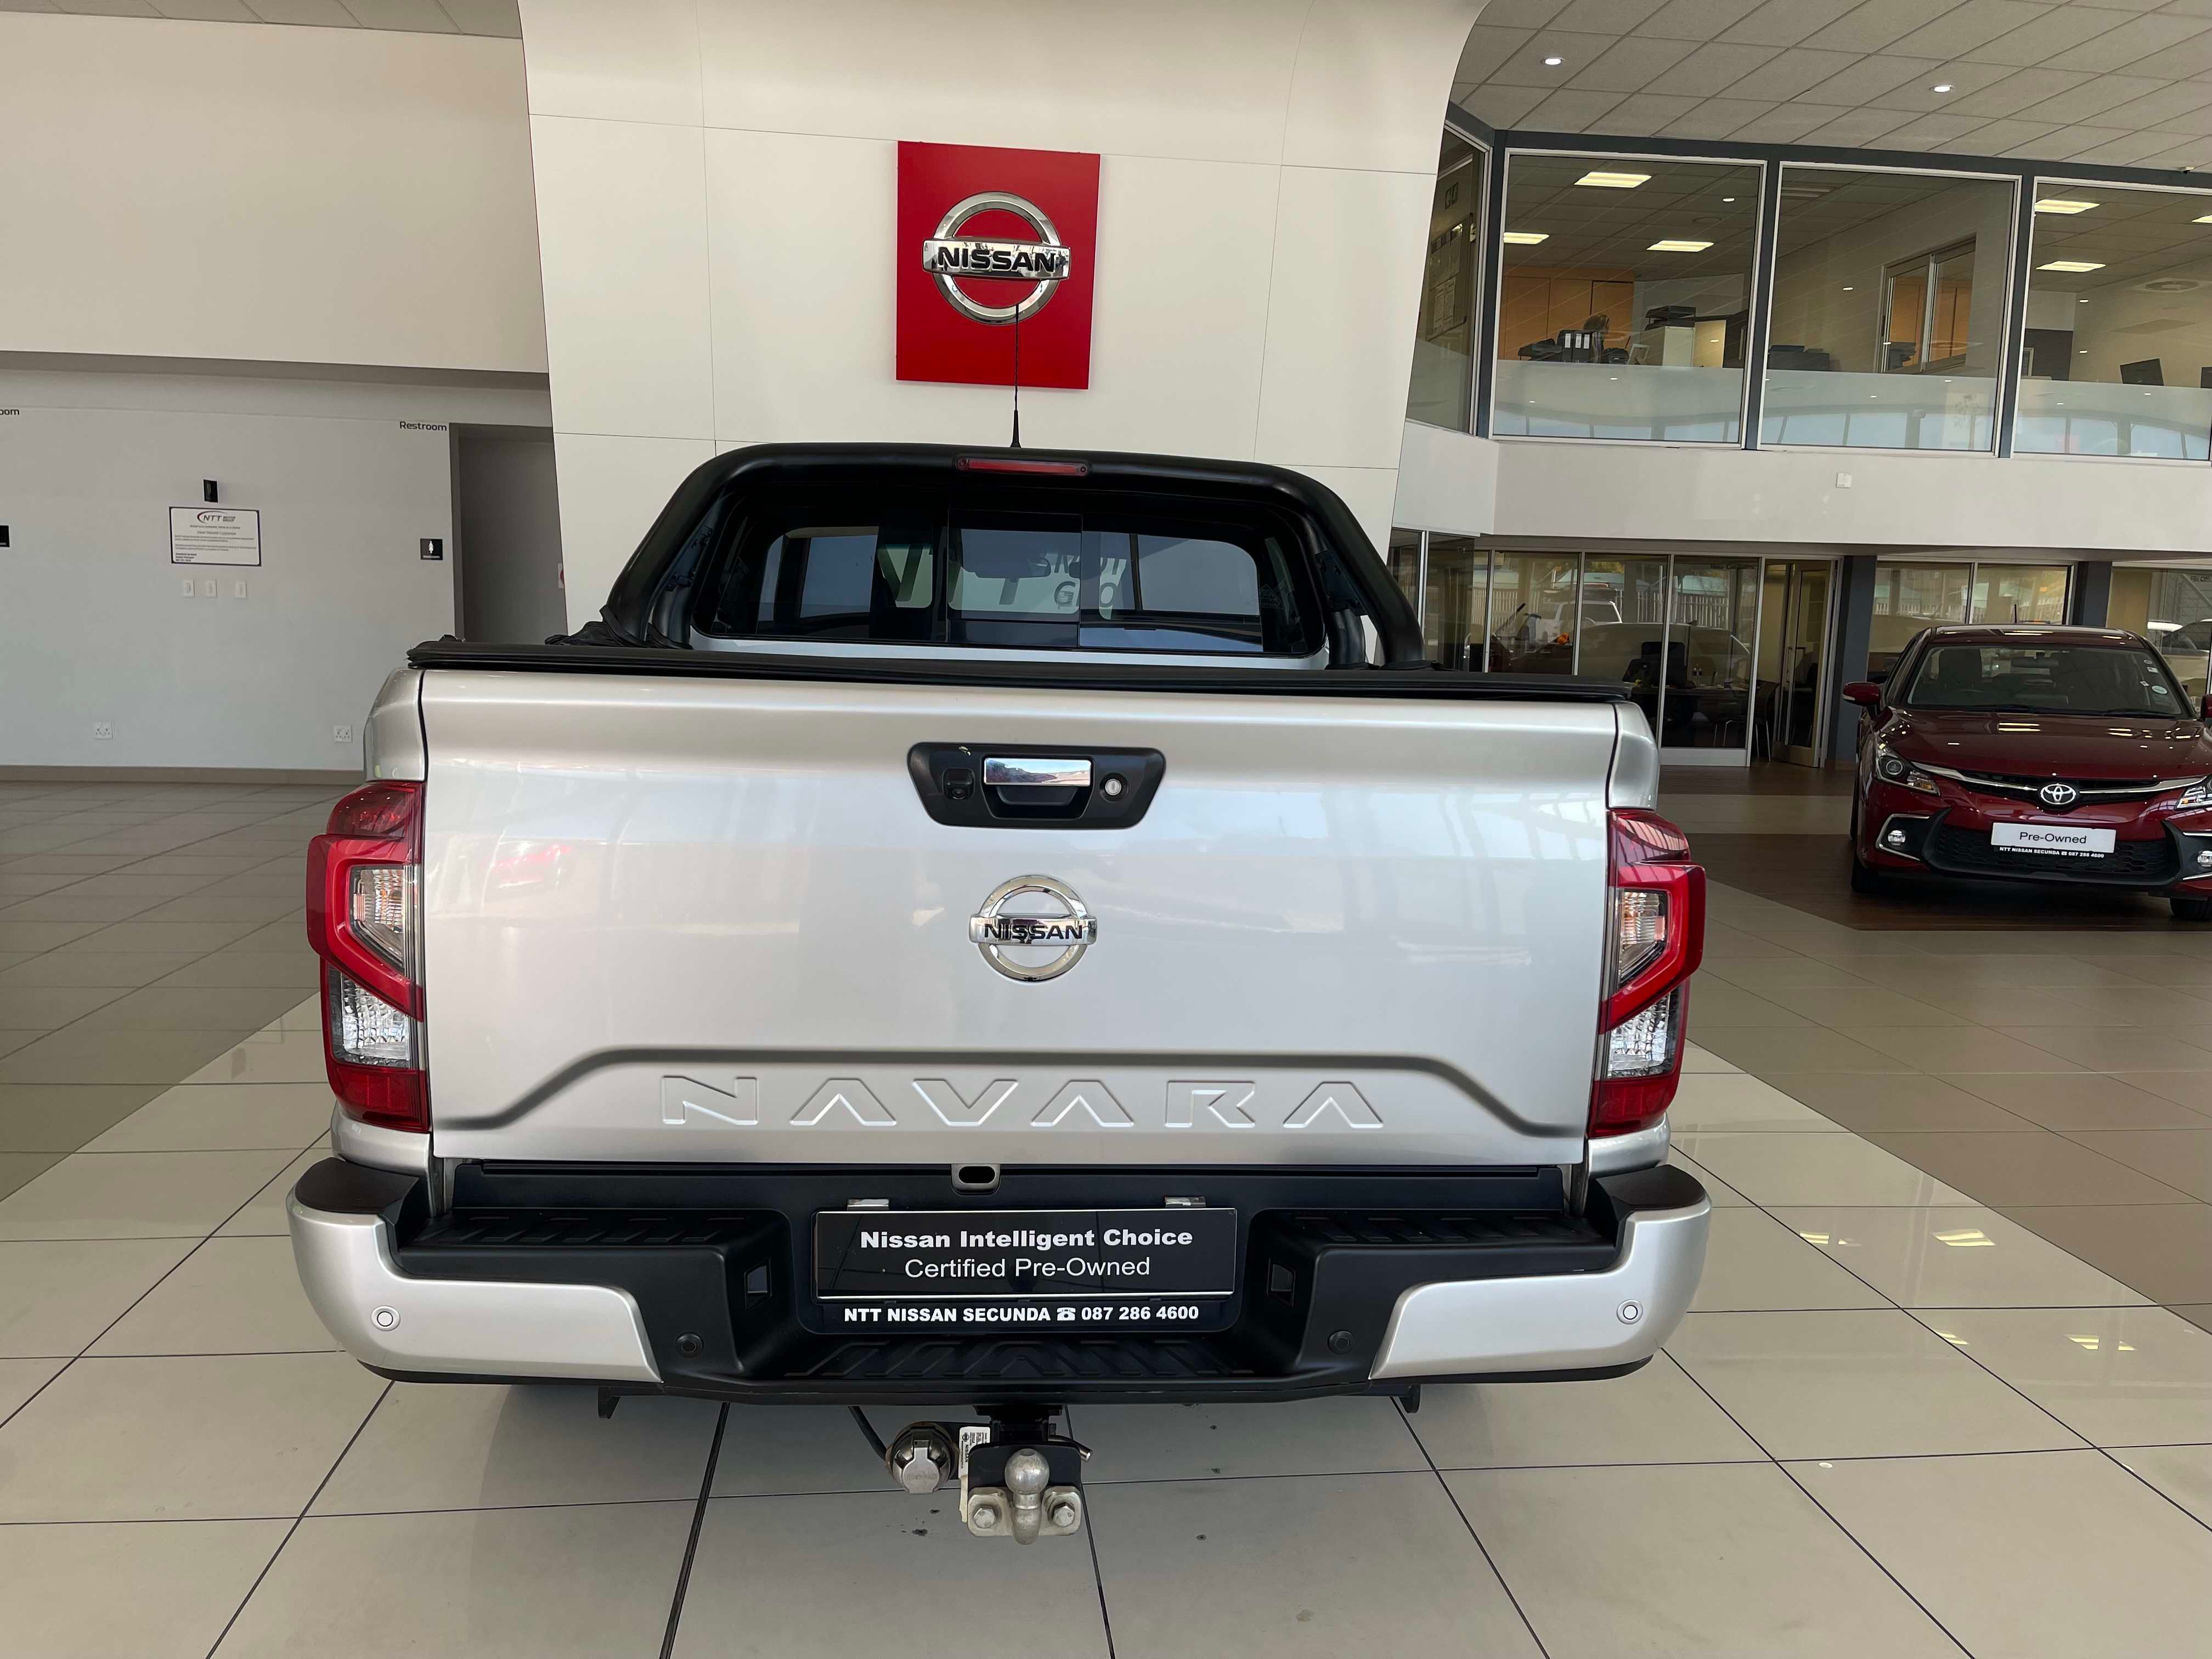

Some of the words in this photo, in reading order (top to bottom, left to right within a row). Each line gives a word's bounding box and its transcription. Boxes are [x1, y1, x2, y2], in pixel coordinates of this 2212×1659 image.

[937, 247, 1054, 272] NISSAN
[399, 421, 447, 431] Restroom
[2019, 832, 2087, 844] Pre-Owned
[984, 923, 1083, 940] NISSAN
[661, 1075, 1384, 1128] NAVARA
[860, 1231, 951, 1249] Nissan
[960, 1229, 1095, 1251] Intelligent
[1103, 1228, 1193, 1246] Choice
[905, 1259, 1006, 1278] Certified
[1015, 1256, 1150, 1277] Pre-Owned
[844, 1308, 882, 1322] NTT
[887, 1308, 957, 1322] NISSAN
[962, 1307, 1051, 1322] SECUNDA
[1081, 1307, 1114, 1321] 087
[1119, 1307, 1151, 1321] 286
[1156, 1306, 1199, 1320] 4600
